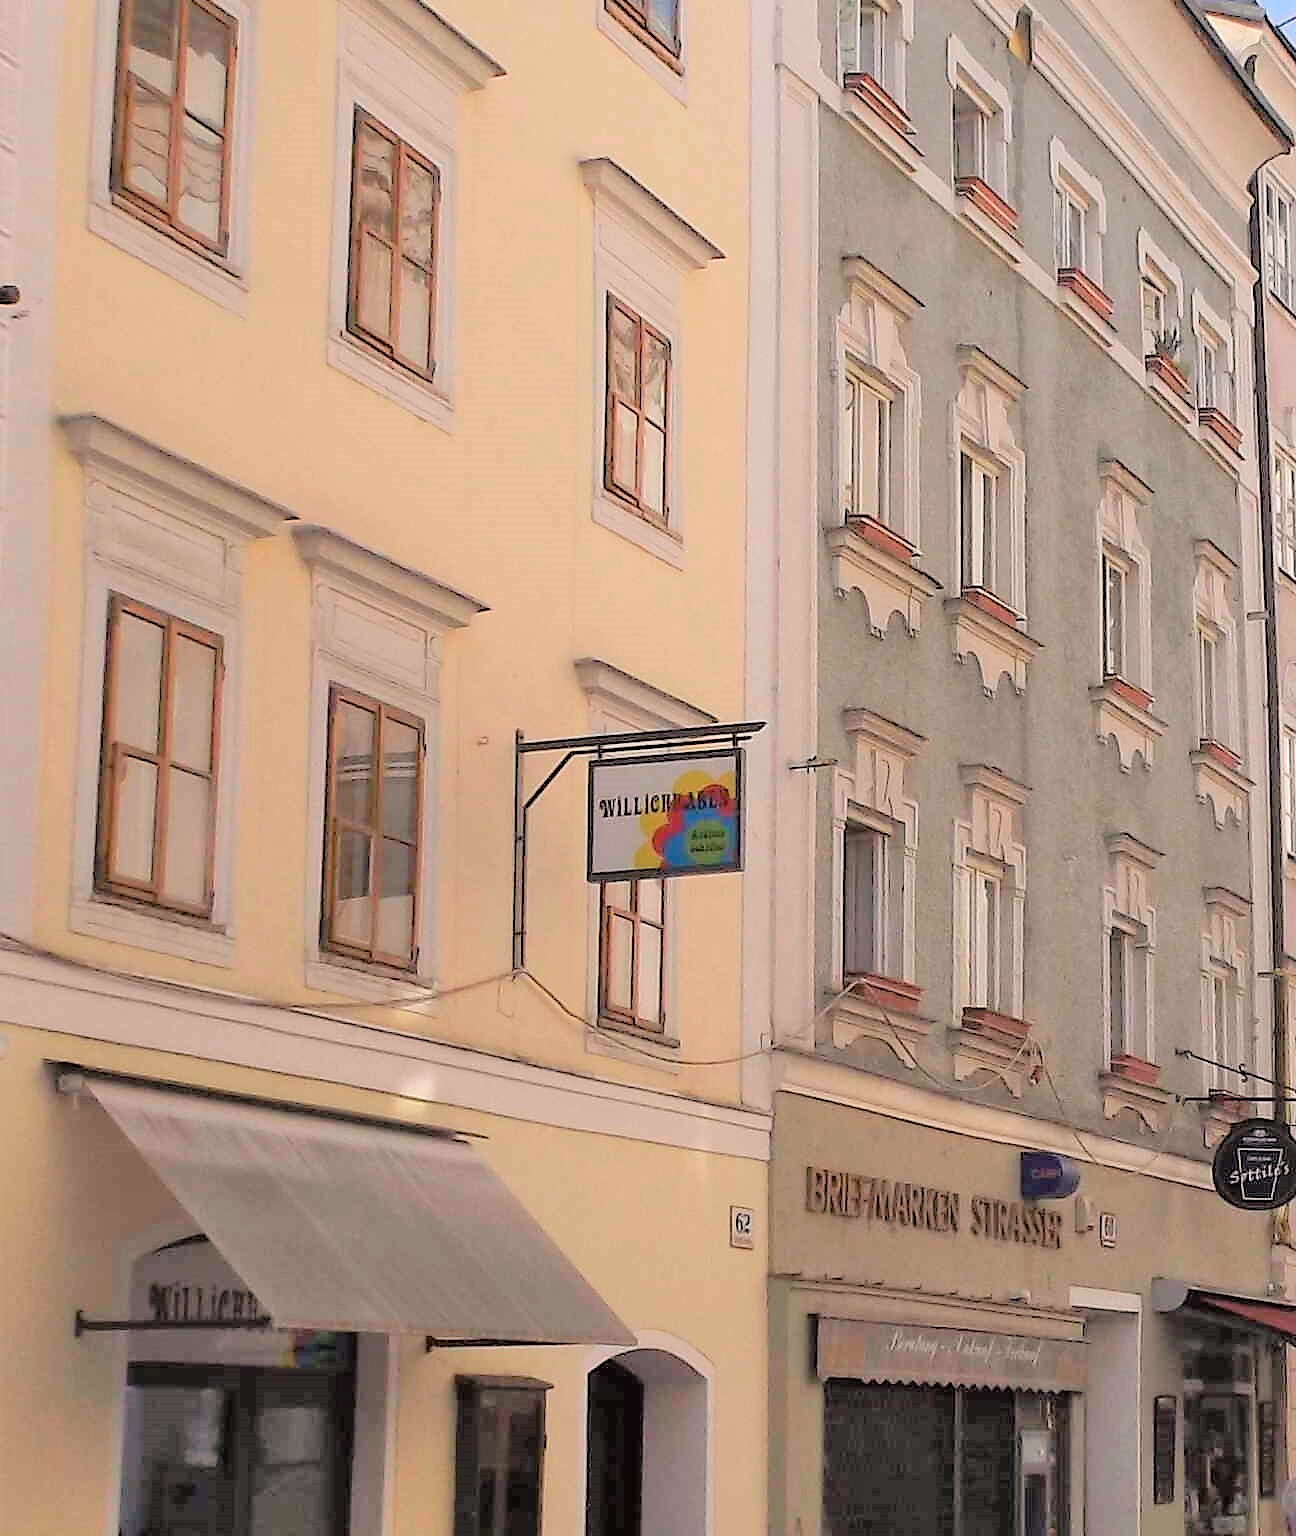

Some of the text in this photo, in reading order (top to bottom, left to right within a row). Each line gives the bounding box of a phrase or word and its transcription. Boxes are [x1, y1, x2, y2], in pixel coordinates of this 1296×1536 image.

[736, 1213, 750, 1234] 62
[806, 1165, 1063, 1251] BRIEFMARKEN STRASSER
